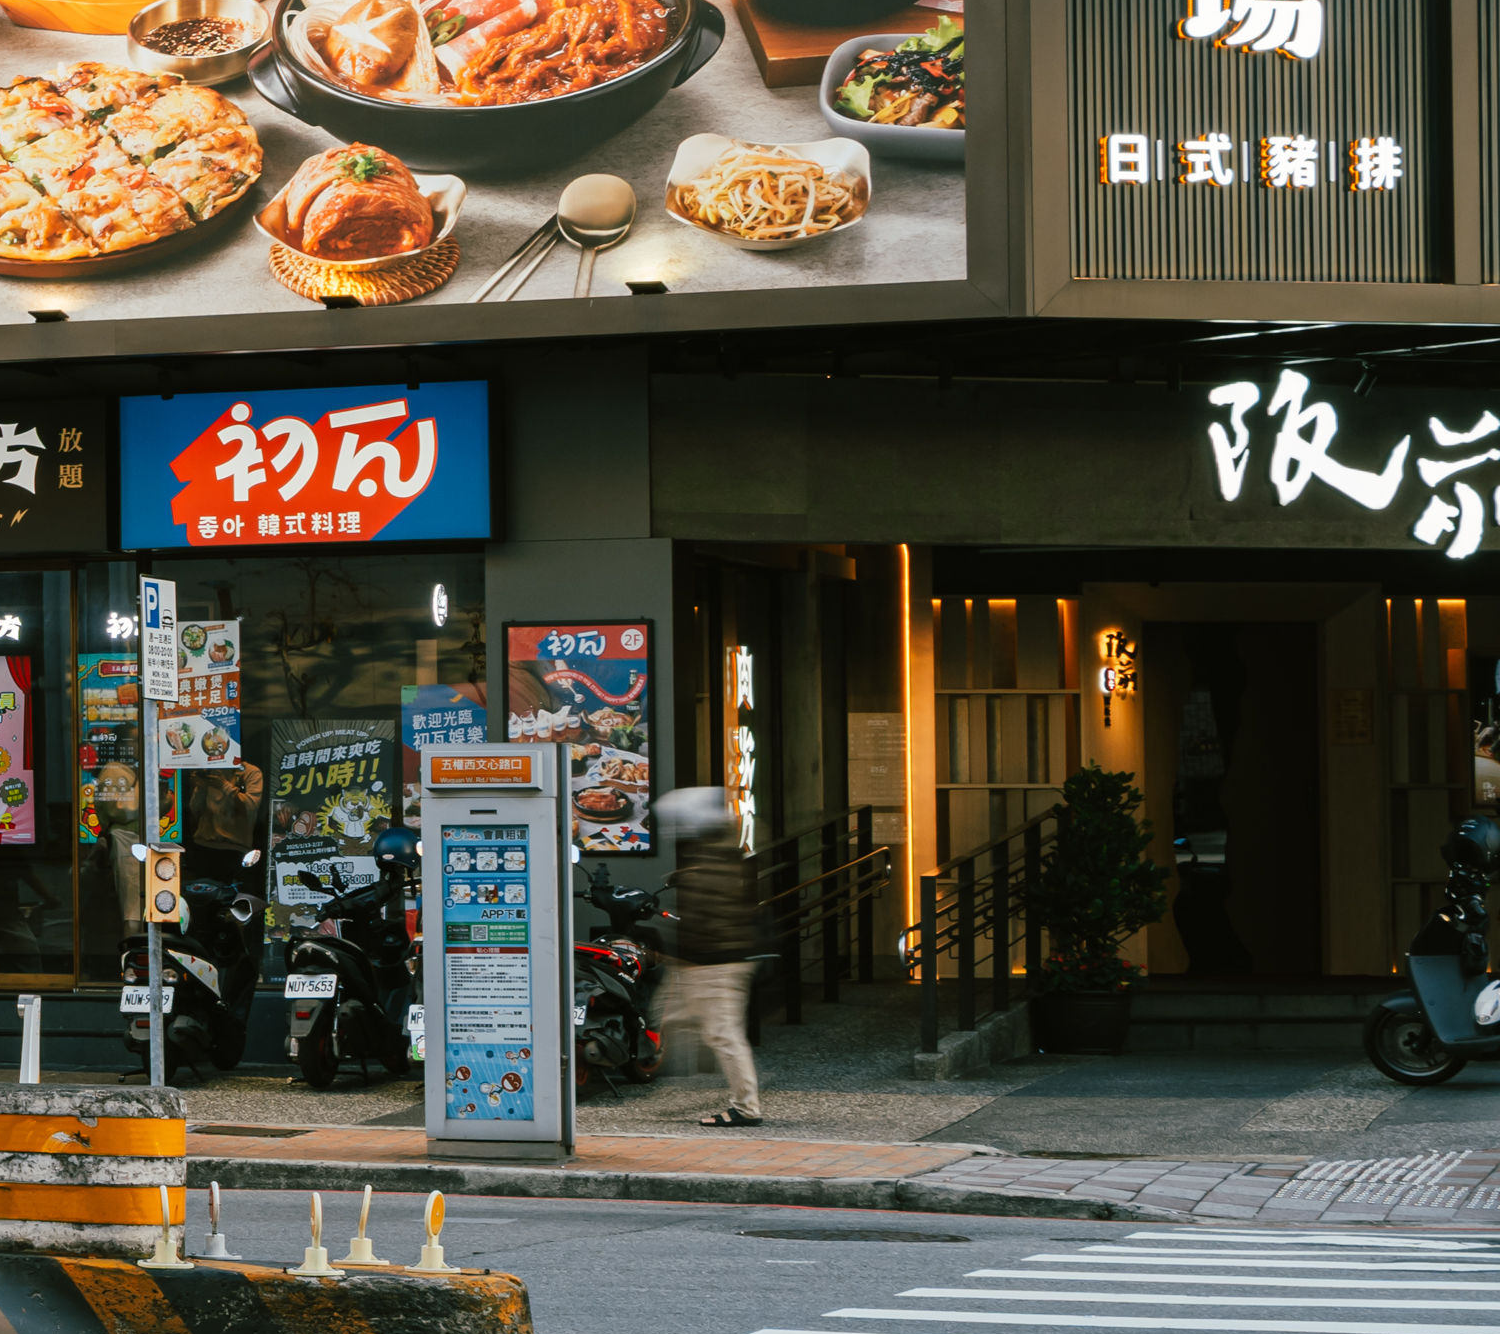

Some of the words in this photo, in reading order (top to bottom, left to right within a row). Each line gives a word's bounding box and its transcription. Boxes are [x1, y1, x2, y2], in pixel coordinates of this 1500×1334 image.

[57, 426, 85, 493] 放題
[197, 514, 245, 539] 좋아
[257, 510, 362, 537] 韓式料理
[145, 586, 158, 624] P
[105, 611, 140, 640] 初
[623, 633, 642, 647] 2F
[178, 673, 224, 694] 典嫩煲
[411, 708, 474, 731] 歡迎光臨
[412, 729, 489, 751] 初瓦娛樂
[279, 738, 383, 771] 這時間來爽吃
[441, 758, 523, 772] 五權西文心路口
[275, 757, 381, 797] 3小時!!
[287, 979, 335, 994] NUY-5653
[124, 993, 170, 1007] NUW-99
